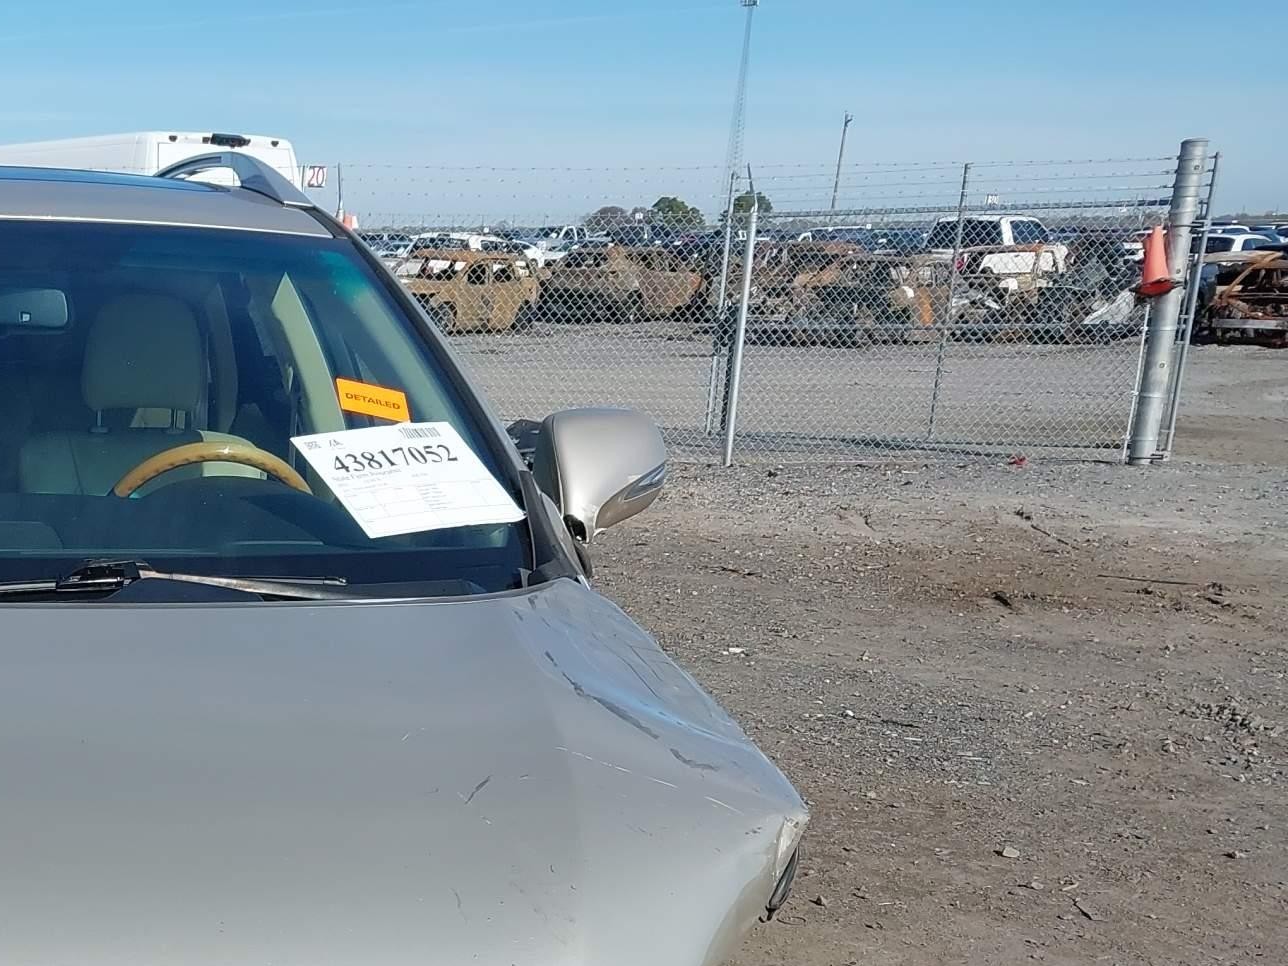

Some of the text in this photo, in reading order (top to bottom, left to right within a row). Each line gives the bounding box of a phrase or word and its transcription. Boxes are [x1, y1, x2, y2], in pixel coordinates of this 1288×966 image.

[307, 165, 325, 188] 20
[345, 392, 401, 410] DETAILED
[334, 444, 458, 473] 43817052
